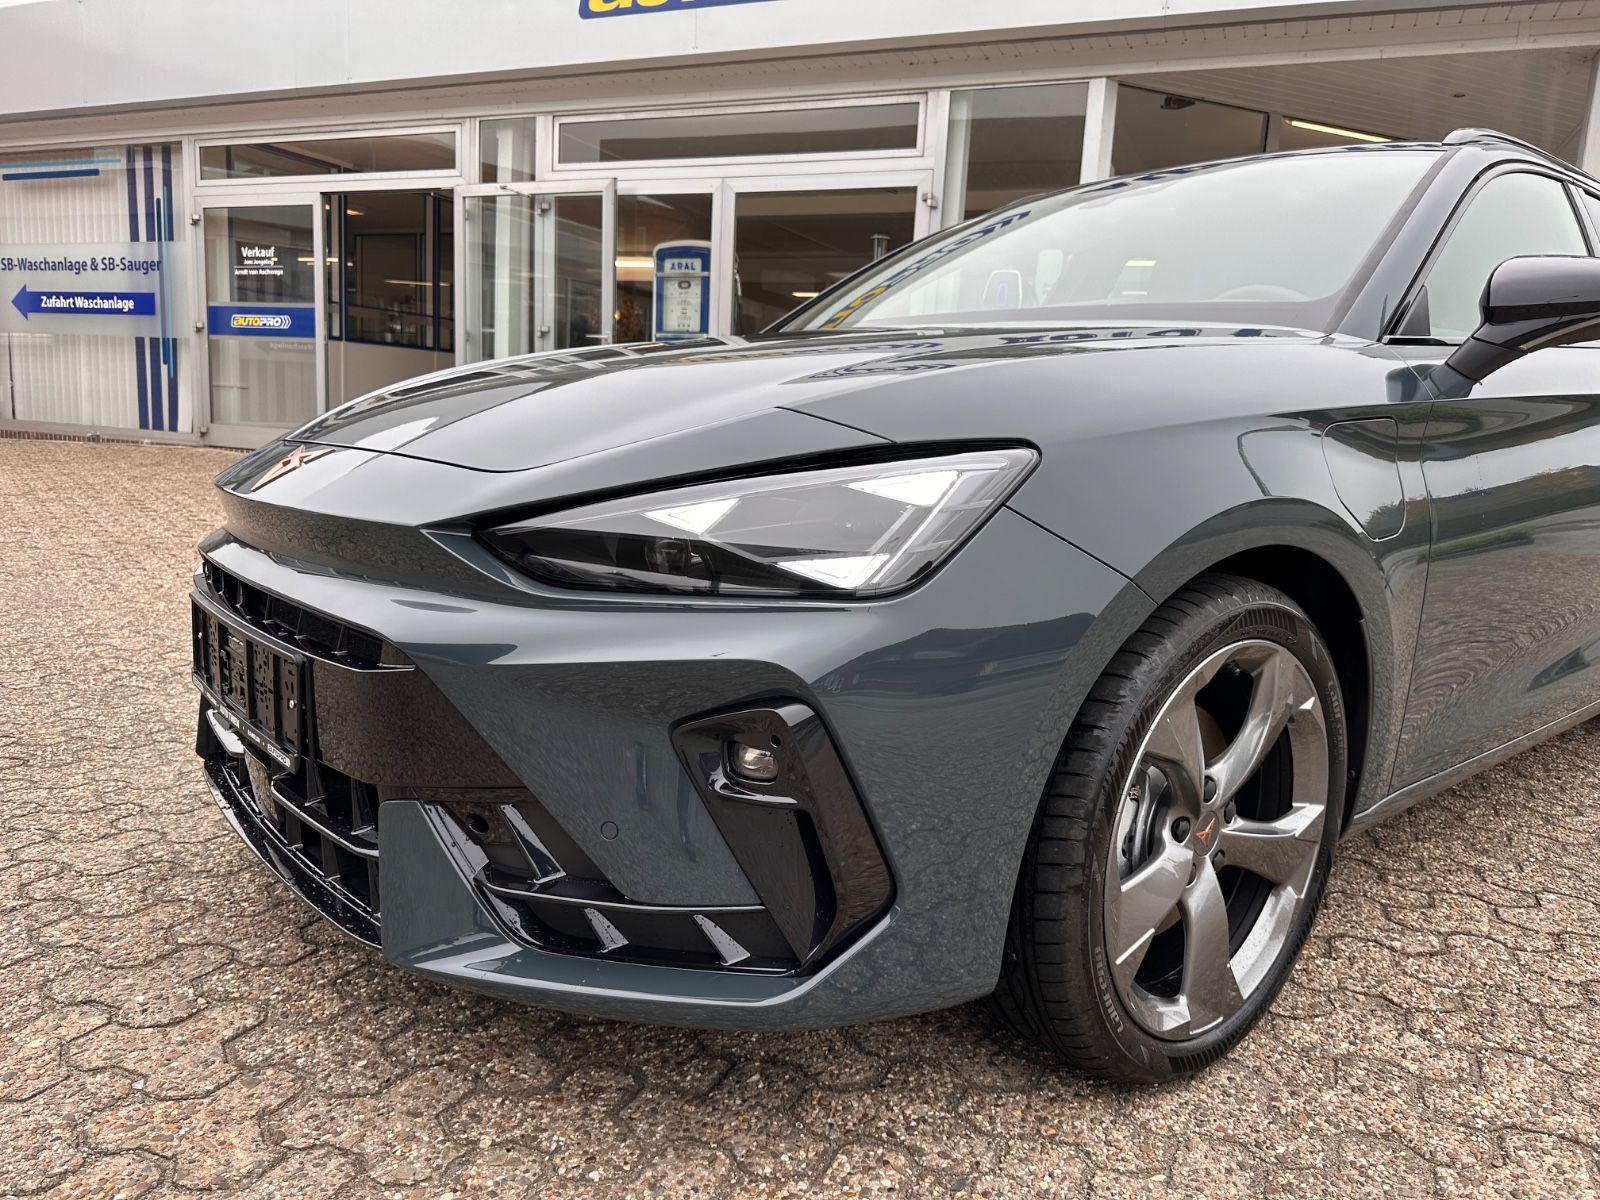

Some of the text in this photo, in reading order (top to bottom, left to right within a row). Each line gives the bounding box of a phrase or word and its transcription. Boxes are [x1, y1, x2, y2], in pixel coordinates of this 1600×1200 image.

[241, 246, 275, 258] Verkauf
[1, 256, 161, 275] SB-Waschanlage & SB-Sauger
[670, 262, 696, 271] ARAL
[40, 296, 134, 311] Zufahrt Waschanlage
